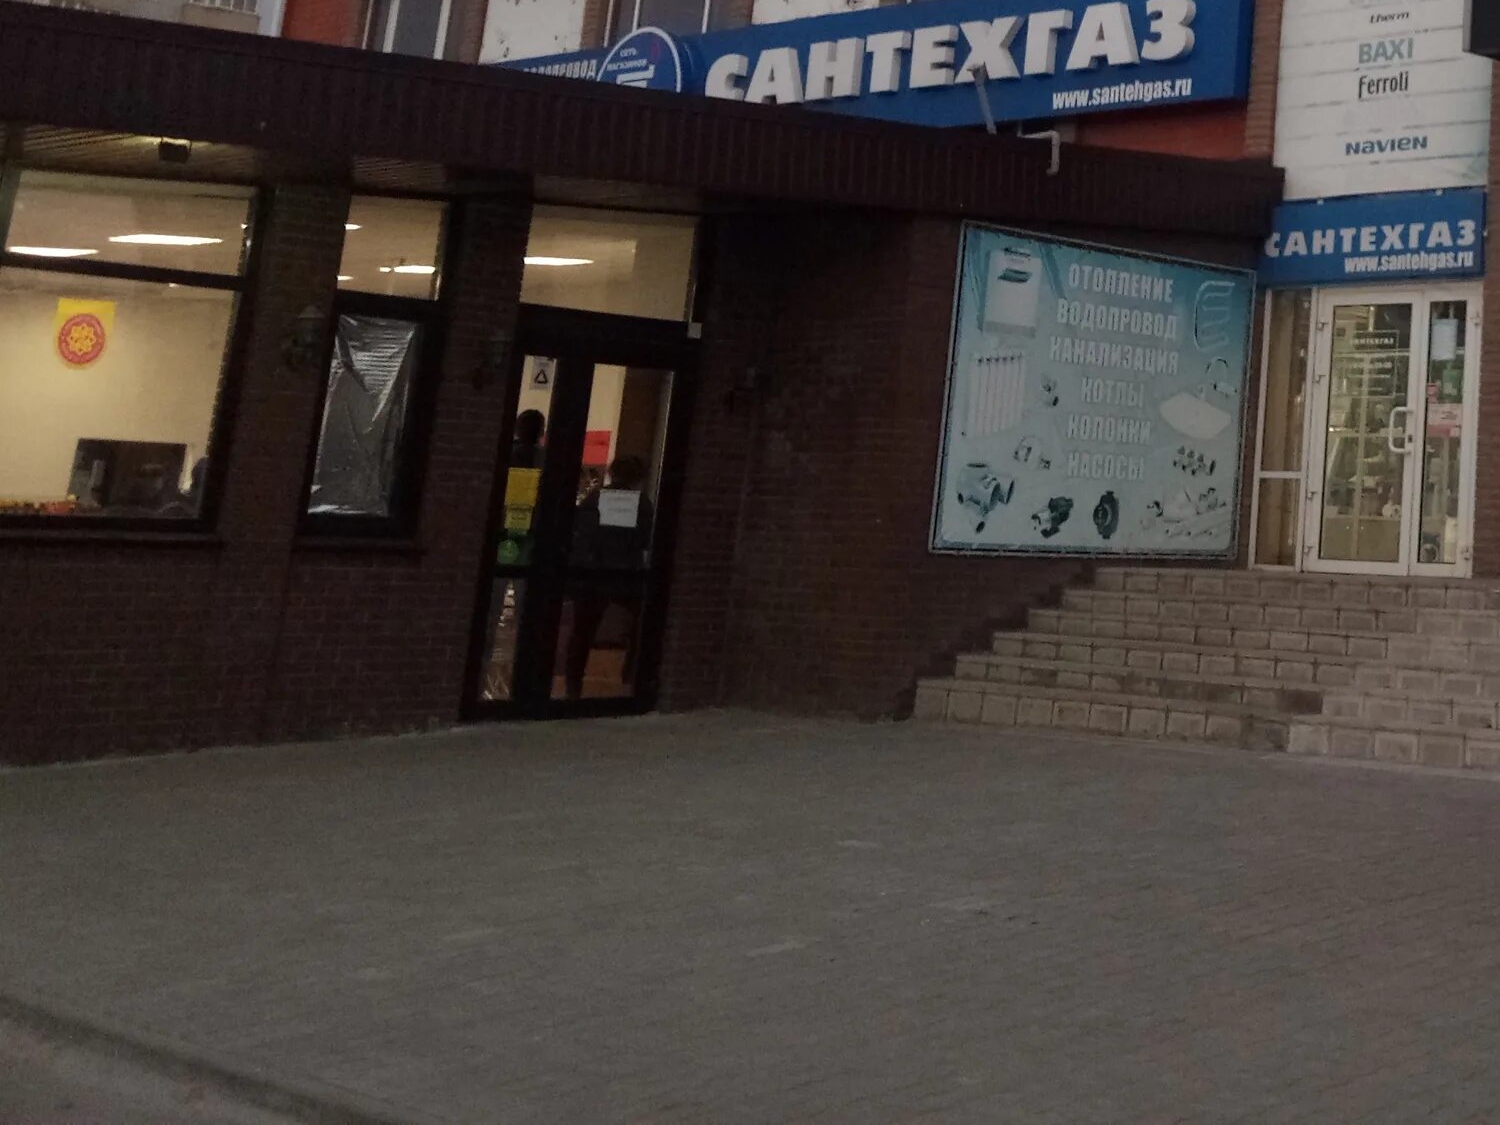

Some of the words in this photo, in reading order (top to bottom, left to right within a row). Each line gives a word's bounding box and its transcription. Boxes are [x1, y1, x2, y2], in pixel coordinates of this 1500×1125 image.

[1358, 38, 1413, 64] BAXI
[1052, 77, 1192, 112] www.santehgas.ru
[1264, 220, 1476, 258] САНТЕХГАЗ
[1344, 251, 1474, 274] www.santehgas.ru
[1068, 263, 1174, 302] ОТОПЛЕНИЕ
[1057, 299, 1178, 340] ВОДОПРОВОД
[1050, 336, 1180, 375] КАНАЛИЗАЦИЯ
[1081, 377, 1145, 408] КОТЛЫ
[1066, 414, 1150, 445] КОЛОНКИ
[1066, 452, 1145, 481] НАСОСЫ
